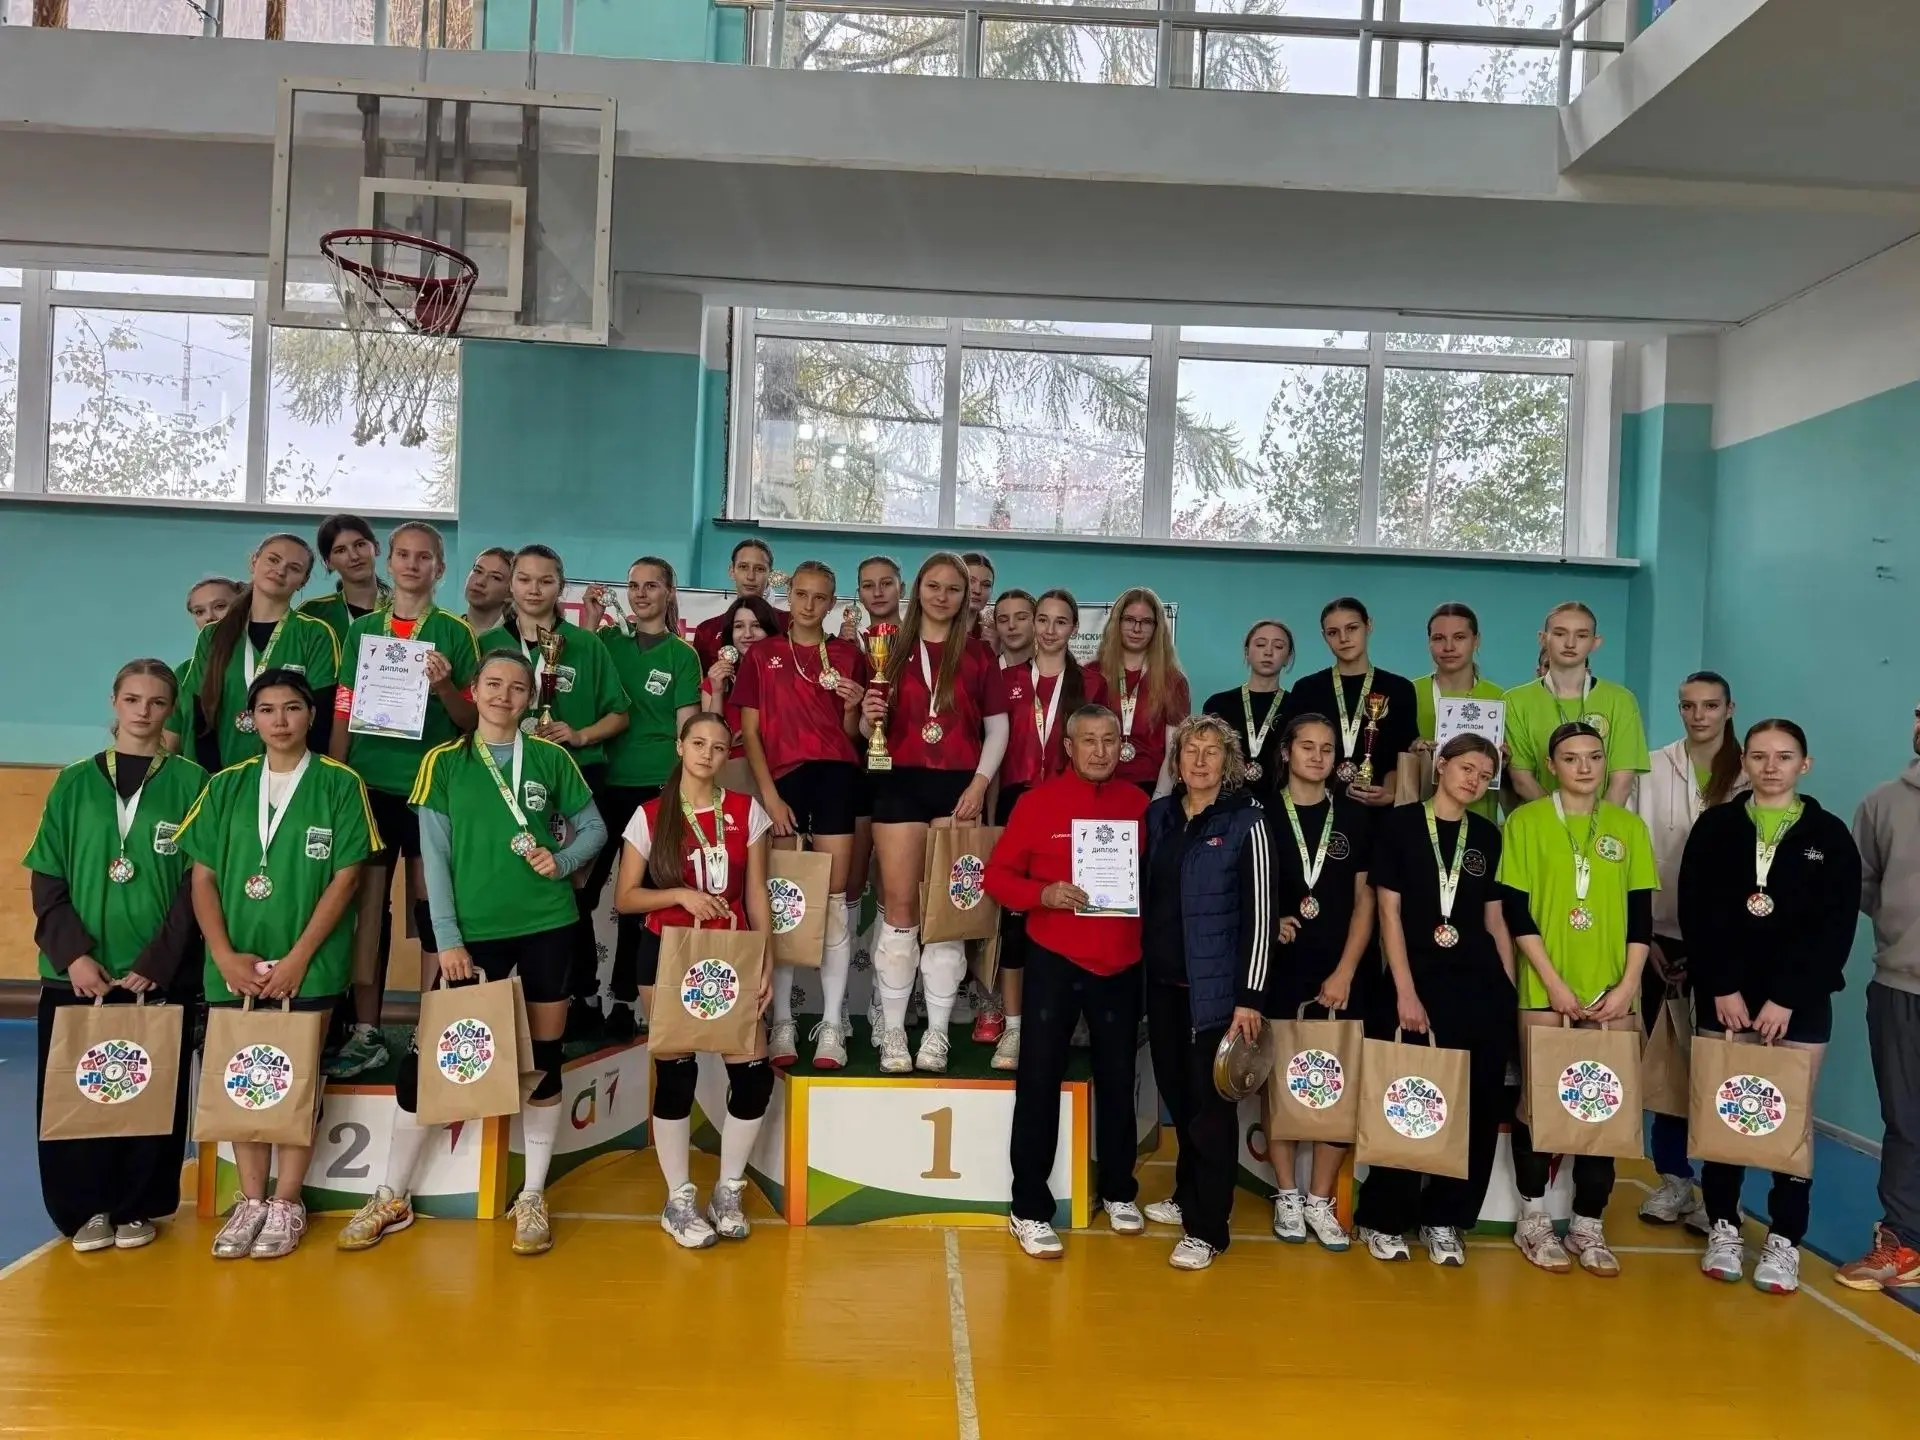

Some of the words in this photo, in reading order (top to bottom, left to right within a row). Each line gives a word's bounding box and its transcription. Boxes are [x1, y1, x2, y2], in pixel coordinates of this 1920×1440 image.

[379, 664, 409, 673] ДИПЛОМ
[687, 847, 729, 894] 10
[326, 1121, 371, 1178] 2
[920, 1106, 962, 1180] 1
